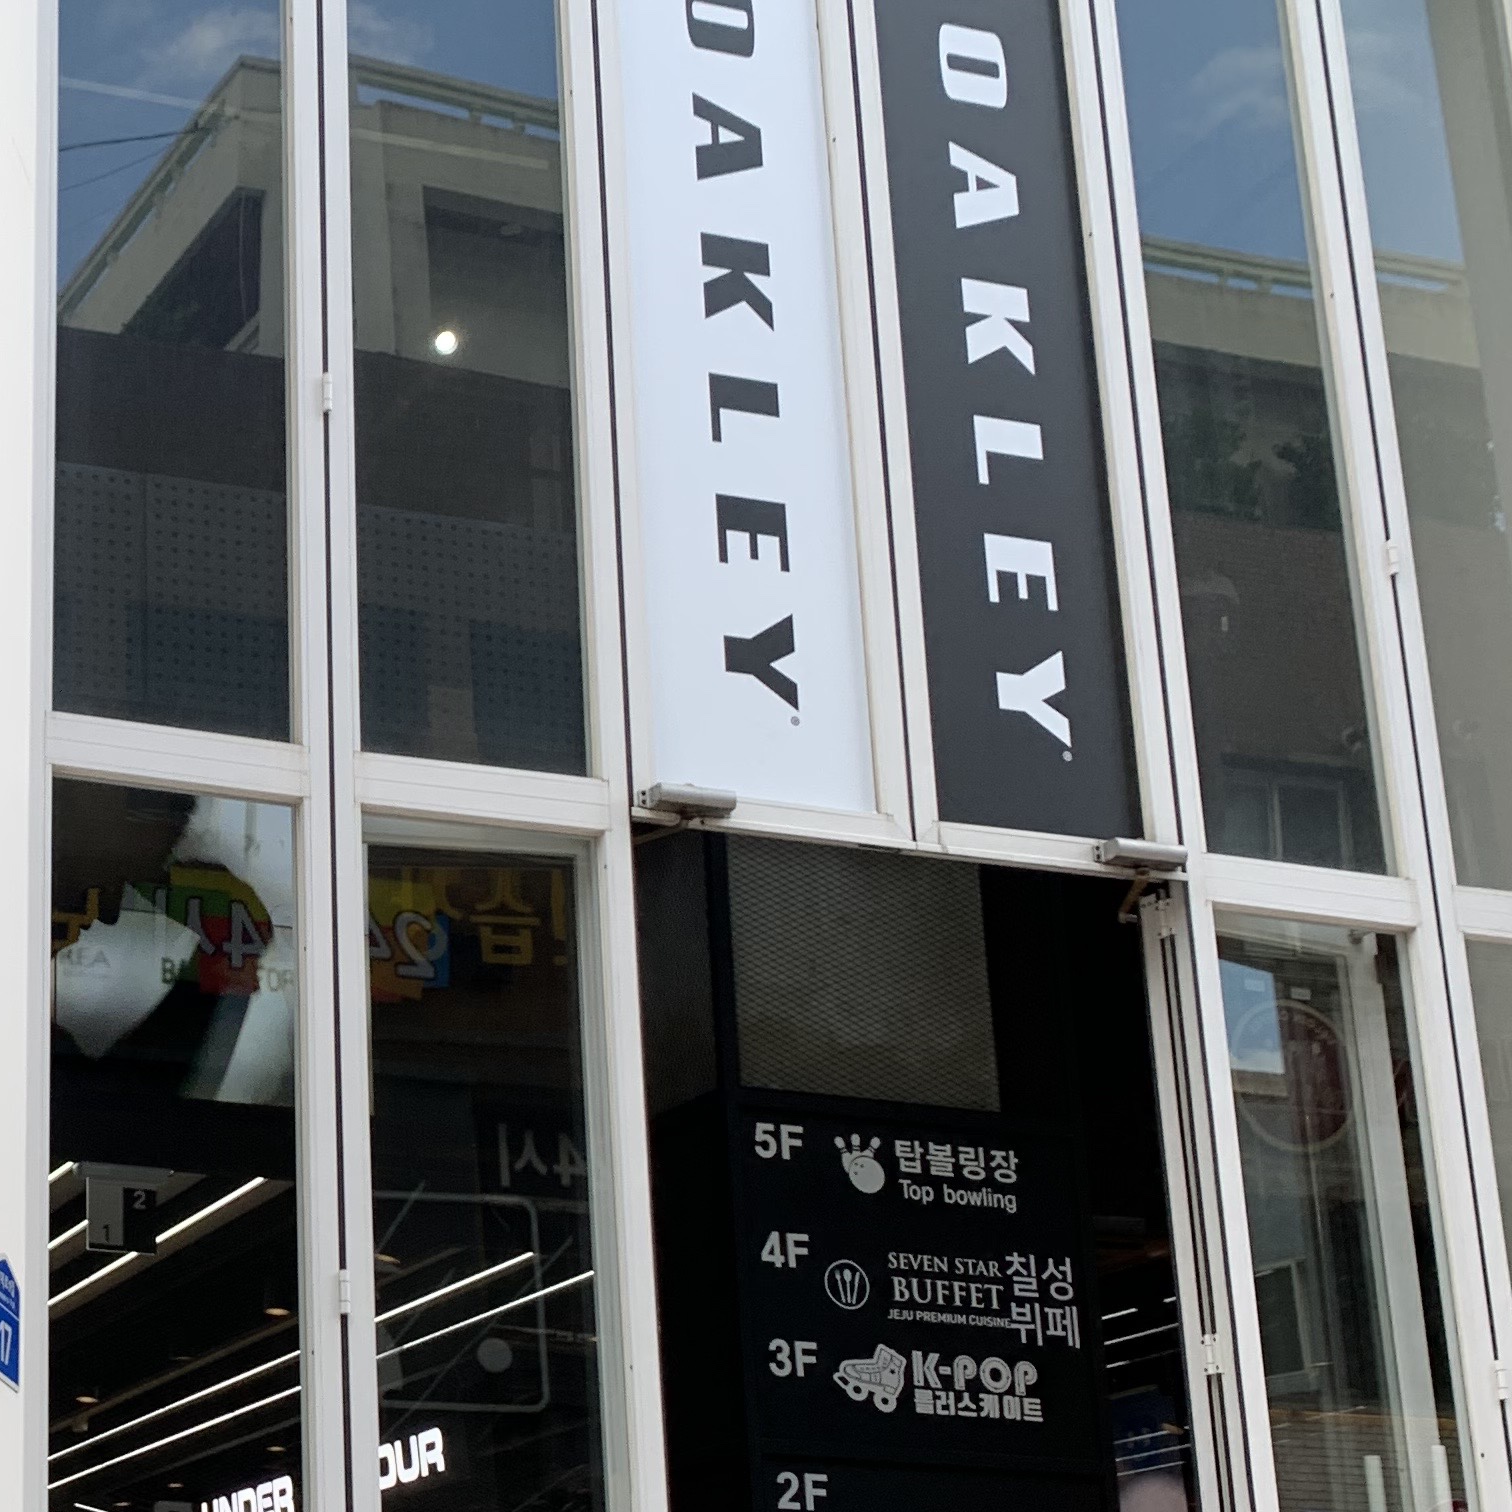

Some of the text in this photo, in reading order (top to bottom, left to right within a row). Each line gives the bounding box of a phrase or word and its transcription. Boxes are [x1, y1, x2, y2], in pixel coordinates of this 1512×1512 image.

[687, 0, 800, 711] OAKLEY
[938, 22, 1072, 749] OAKLEY
[754, 1122, 803, 1160] 5F
[894, 1139, 1019, 1184] 탑볼링장
[133, 1189, 146, 1210] 2
[897, 1179, 1018, 1214] Top bowling
[760, 1231, 810, 1268] 4F
[888, 1251, 1003, 1279] SEVEN STAR
[891, 1277, 1004, 1310] BUFFET
[1004, 1251, 1075, 1301] 칠성
[888, 1309, 1012, 1329] JEJU PREMIUM CUISINE
[1009, 1301, 1081, 1350] 뷔페
[768, 1338, 818, 1377] 3F
[911, 1349, 1039, 1397] K-POP
[776, 1472, 829, 1511] 2F
